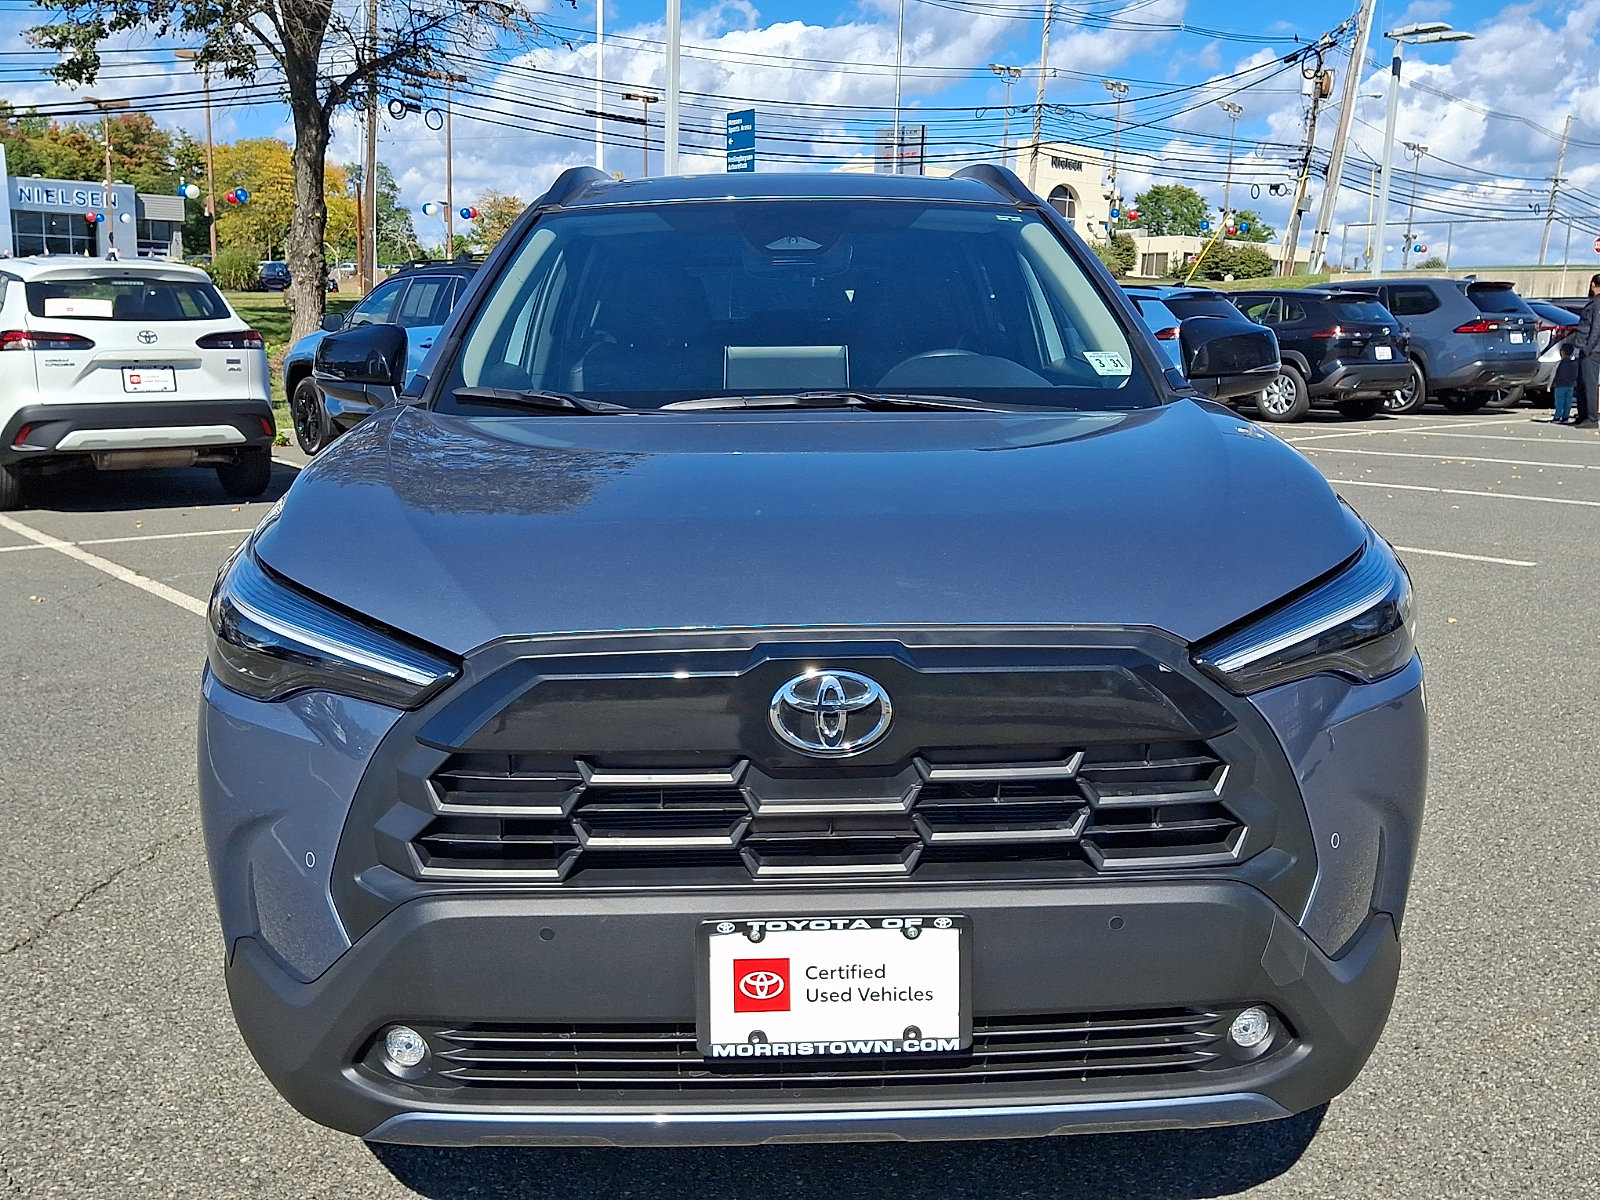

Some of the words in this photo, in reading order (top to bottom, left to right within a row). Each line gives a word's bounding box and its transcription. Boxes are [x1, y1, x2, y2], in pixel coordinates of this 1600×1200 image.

[18, 186, 118, 209] NIELSEN
[1095, 358, 1105, 368] 3
[1110, 358, 1125, 368] 31
[747, 919, 873, 932] TOYOTA
[881, 918, 923, 930] OF
[805, 964, 886, 980] Certified
[806, 987, 852, 1003] Used
[857, 986, 934, 1002] Vehicles
[712, 1038, 960, 1058] MORRISTOWN.COM
